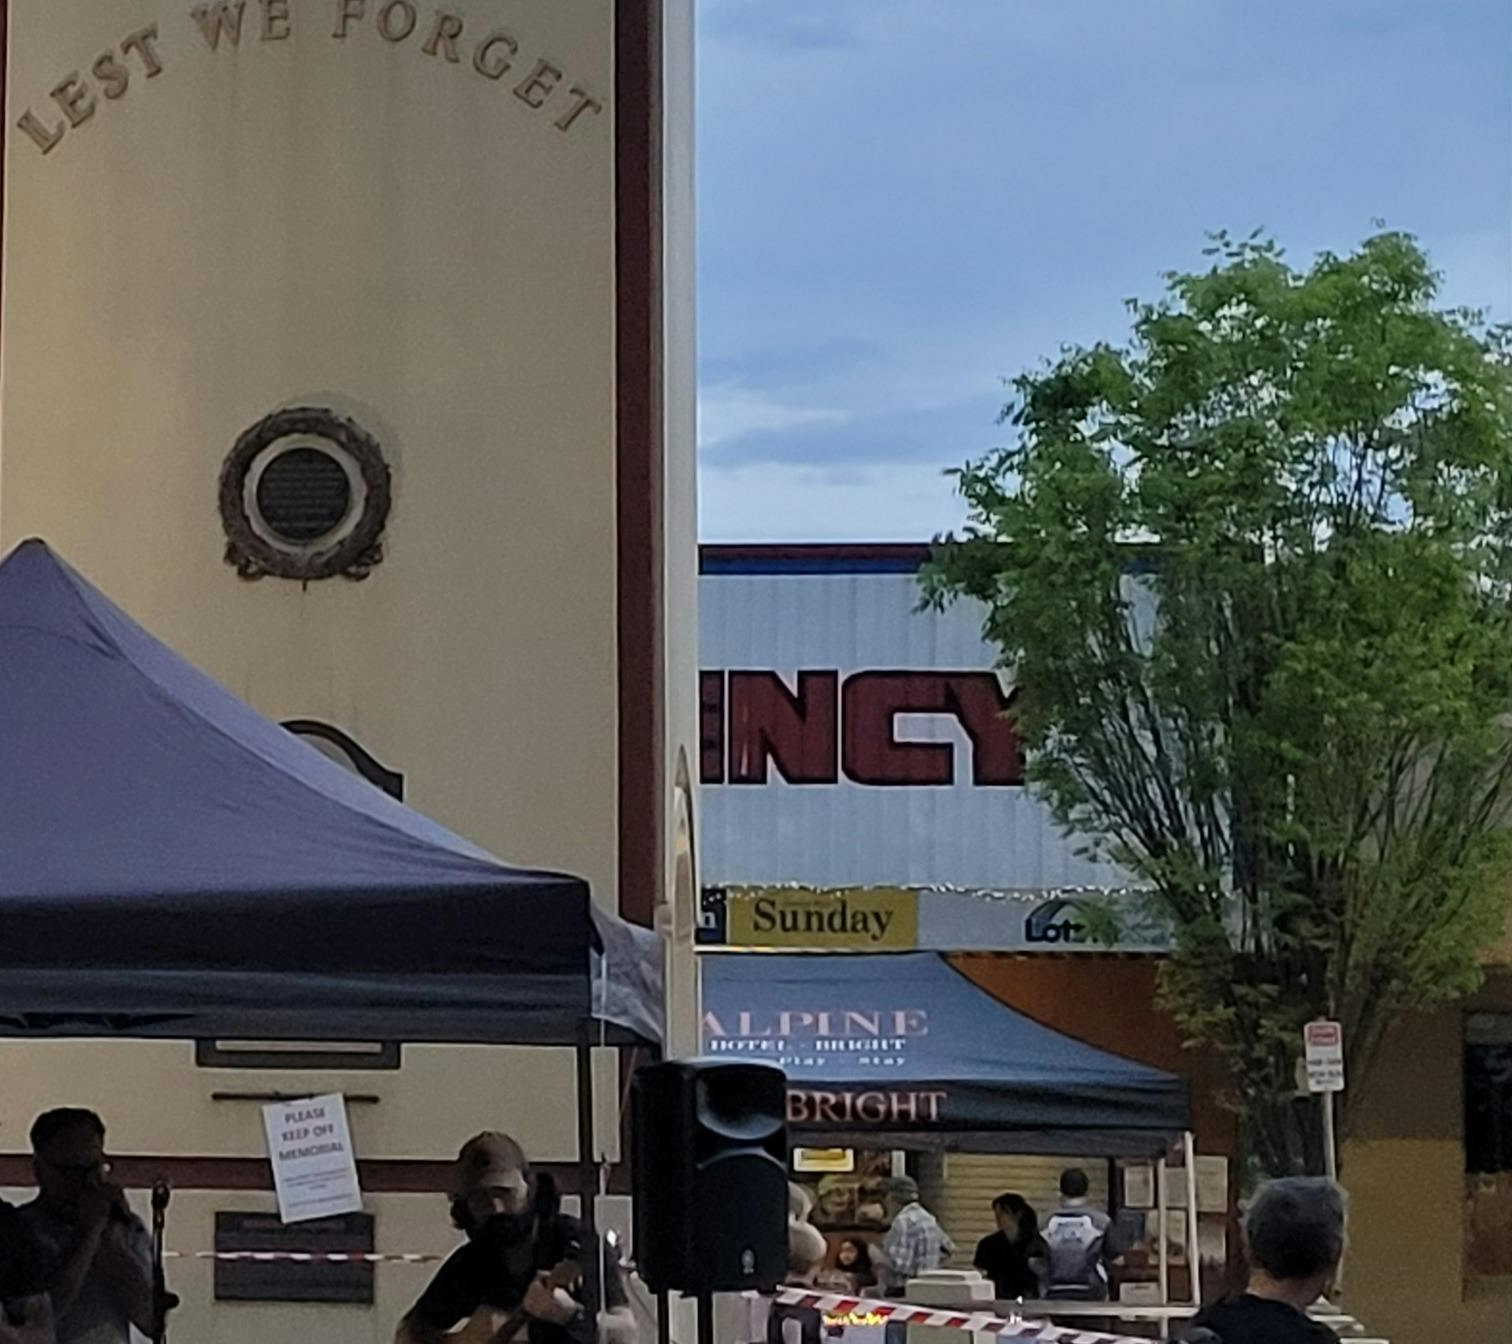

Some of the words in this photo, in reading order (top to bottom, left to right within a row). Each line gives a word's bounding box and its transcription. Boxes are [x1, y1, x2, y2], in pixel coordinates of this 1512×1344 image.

[16, 22, 163, 155] LEST
[700, 669, 1026, 787] NCY
[753, 898, 894, 942] Sunday
[710, 1039, 786, 1052] HOTEL
[815, 1039, 906, 1052] BRIGHT
[285, 1107, 326, 1124] PLEASE
[786, 1090, 948, 1123] BRIGHT
[282, 1127, 310, 1142] KEEP
[313, 1123, 334, 1137] OFF
[278, 1142, 345, 1161] MEMORIAL
